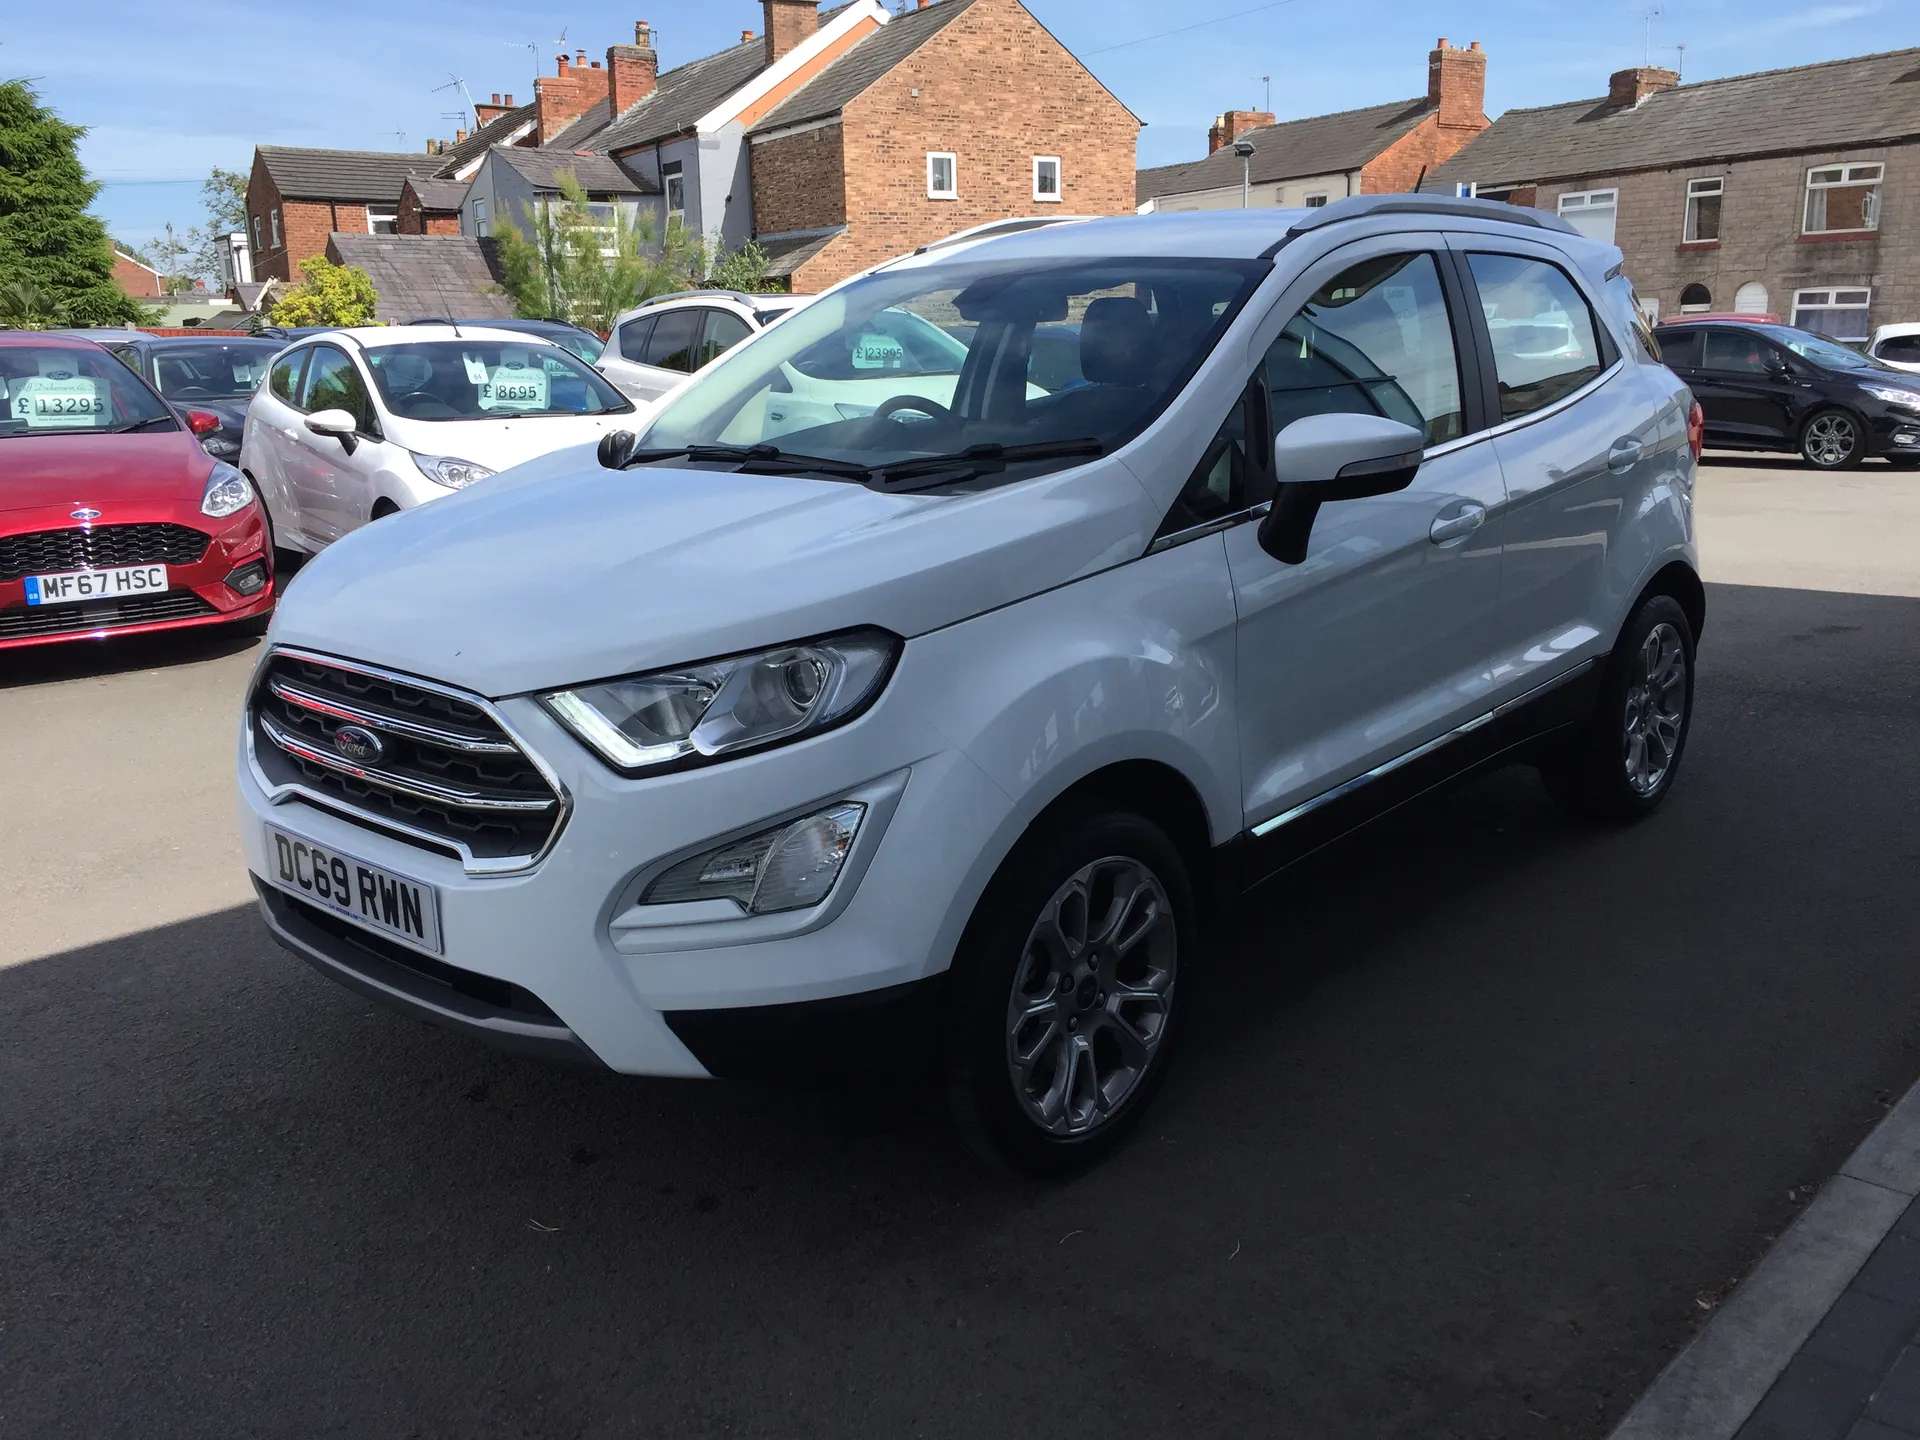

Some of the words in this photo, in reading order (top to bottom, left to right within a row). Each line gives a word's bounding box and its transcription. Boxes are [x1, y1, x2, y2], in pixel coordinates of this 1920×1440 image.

[43, 573, 108, 598] MF67
[116, 568, 163, 591] HSC
[275, 833, 350, 907] DC69
[357, 866, 424, 939] RWN
